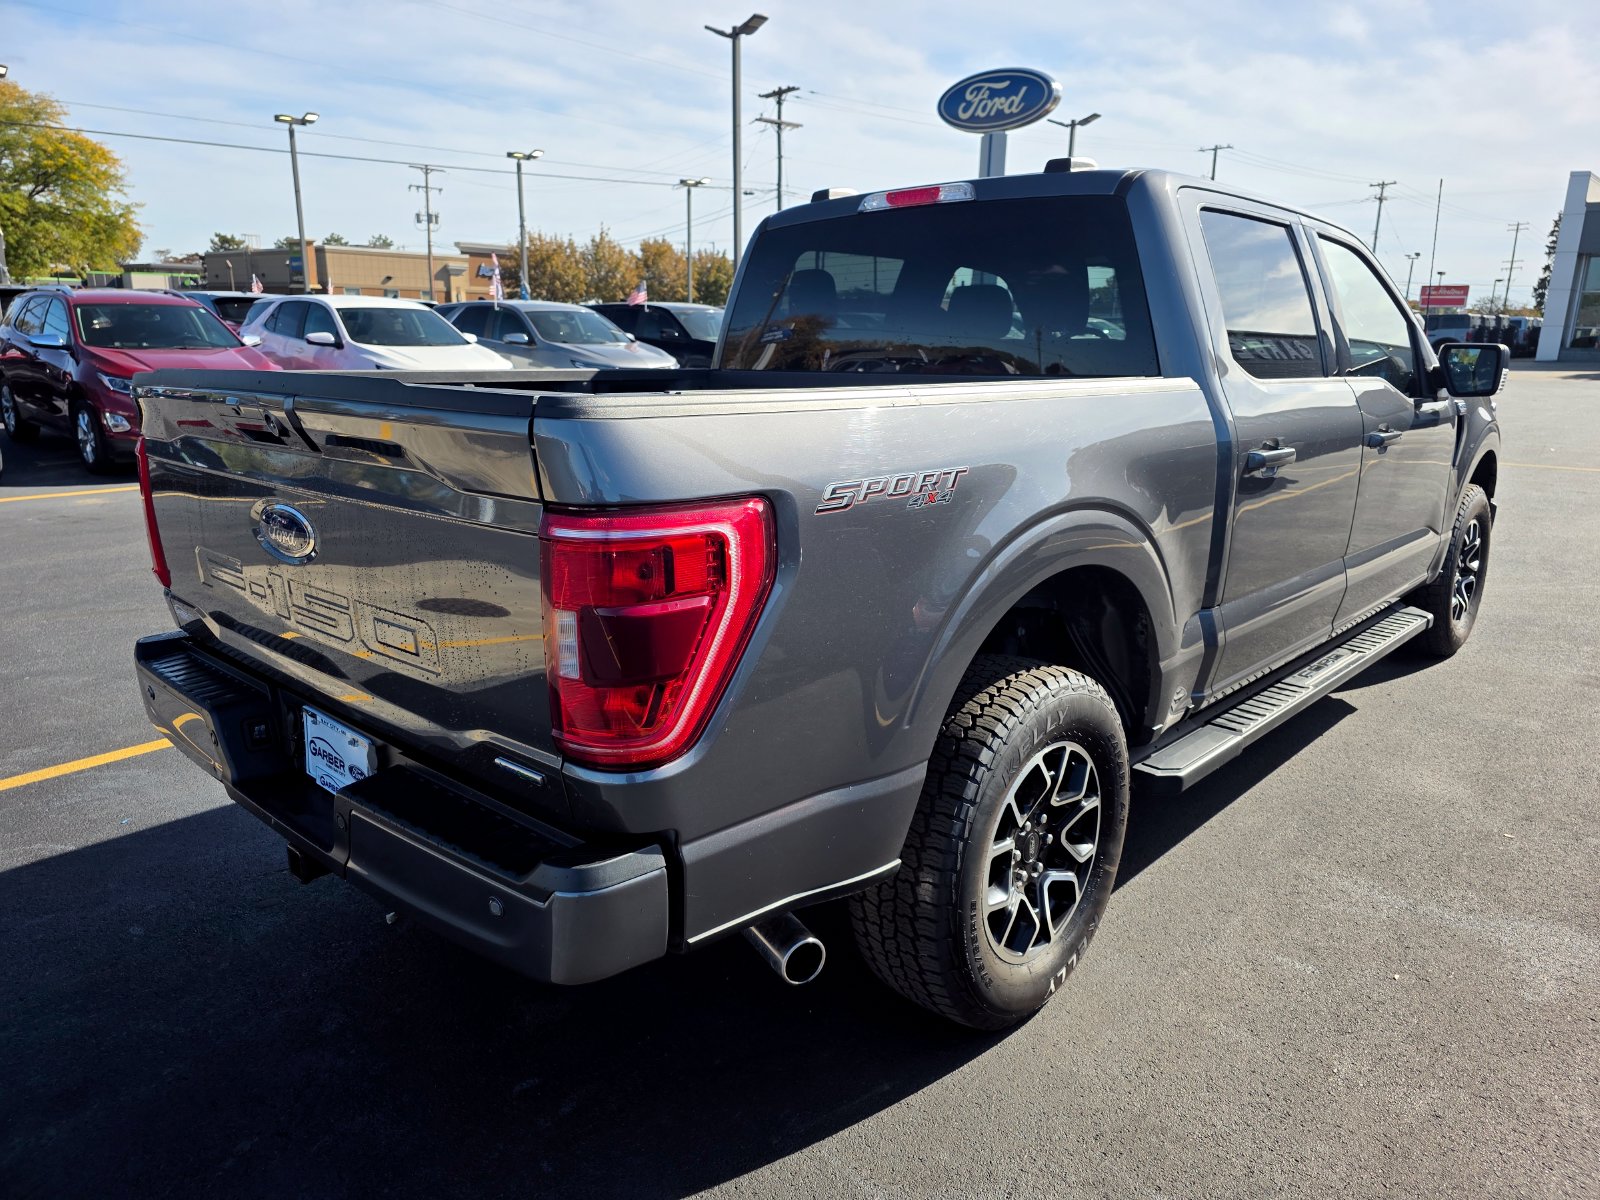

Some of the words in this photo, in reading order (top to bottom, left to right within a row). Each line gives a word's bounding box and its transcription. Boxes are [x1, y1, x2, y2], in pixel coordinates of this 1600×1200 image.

[958, 80, 1028, 119] Ford
[814, 466, 969, 515] SPORT
[195, 545, 442, 676] F-150
[309, 739, 346, 773] GARBER
[320, 775, 340, 792] GARBE
